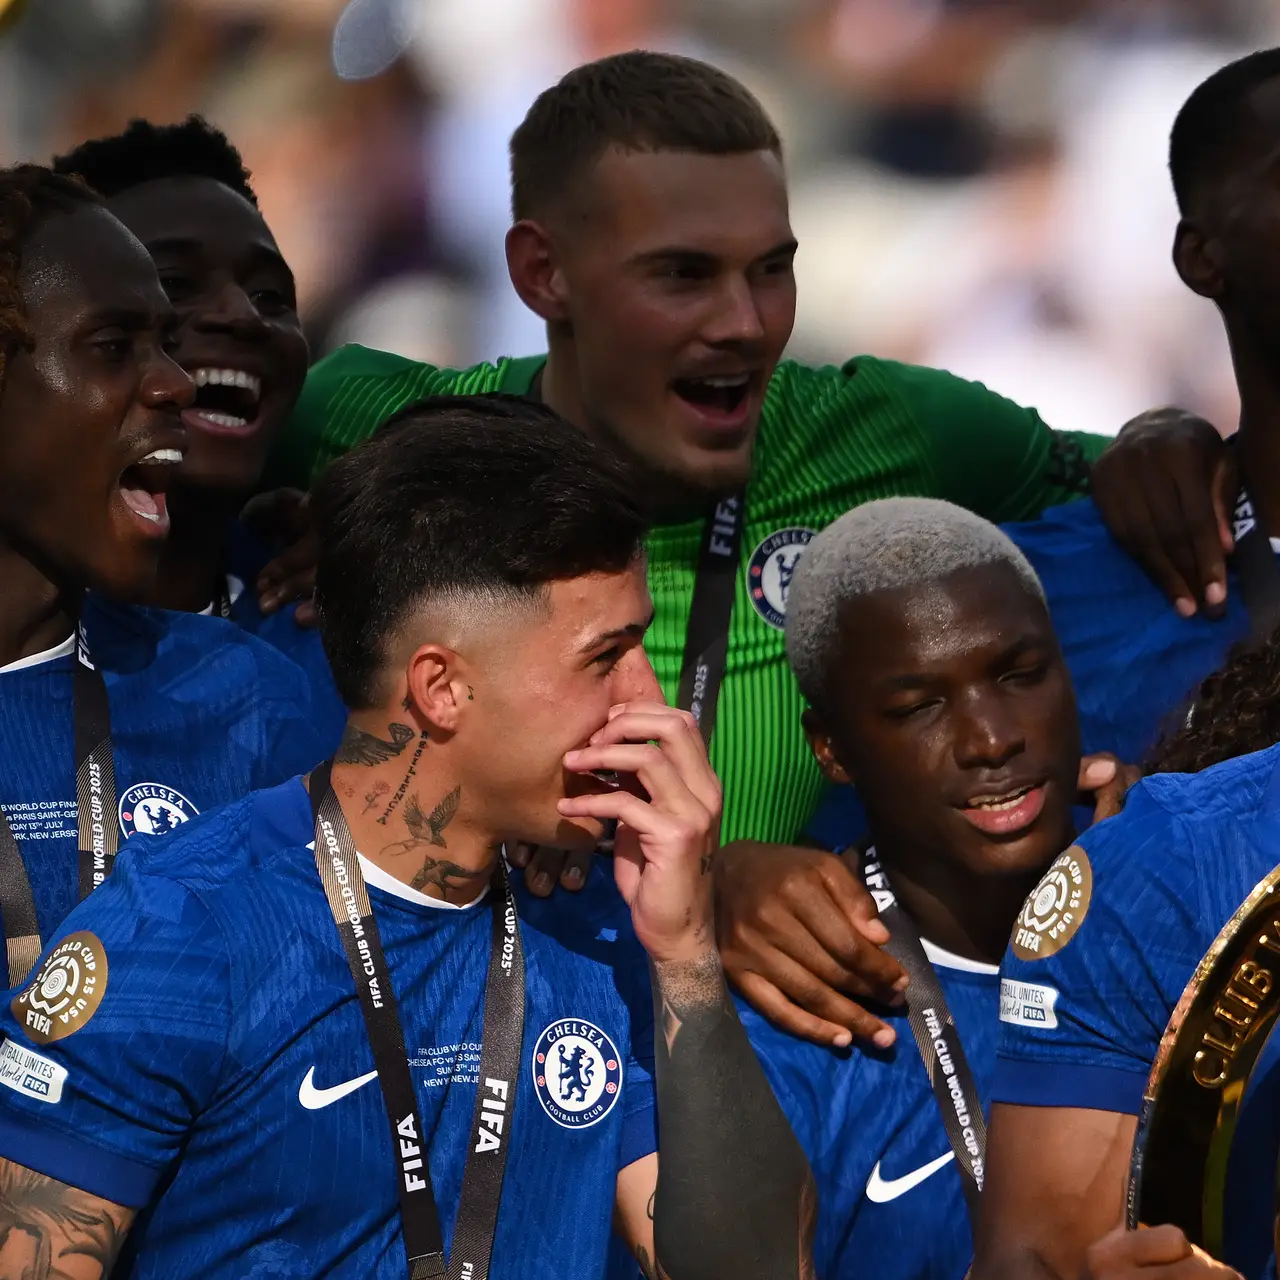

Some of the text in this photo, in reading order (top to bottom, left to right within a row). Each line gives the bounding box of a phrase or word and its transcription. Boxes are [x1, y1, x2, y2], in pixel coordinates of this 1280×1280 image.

[78, 619, 95, 671] FIF
[7, 803, 39, 811] WORLD
[40, 801, 58, 810] CUP
[59, 800, 78, 809] FINA
[91, 791, 103, 820] CUP
[127, 787, 185, 809] CHELSEA
[13, 812, 36, 821] PARIS
[37, 810, 78, 820] SAINT-GE
[44, 820, 63, 829] JULY
[30, 829, 78, 840] NEW JERSE
[93, 825, 105, 869] WORLD
[333, 857, 348, 884] CUP
[342, 886, 365, 939] WORLD
[1048, 860, 1083, 940] CUP 25 USA
[504, 907, 517, 934] CUP
[1015, 927, 1042, 953] FIFA
[357, 939, 376, 976] CLUB
[44, 941, 96, 1025] WORLD CUP 25 USA
[368, 977, 384, 1010] FIFA
[1018, 986, 1045, 1004] UNITES
[26, 1009, 52, 1036] FIFA
[1024, 1007, 1045, 1020] FIFA
[1192, 959, 1274, 1089] CLUB
[546, 1024, 605, 1049] CHELSEA
[428, 1045, 449, 1055] CLUB
[433, 1056, 445, 1066] FC
[24, 1055, 56, 1079] UNITES
[24, 1077, 48, 1094] FIFA
[424, 1078, 442, 1088] NEW
[451, 1075, 470, 1083] NEW
[922, 1008, 943, 1039] FIFA
[934, 1039, 955, 1075] CLUB
[946, 1074, 970, 1127] WORLD
[962, 1127, 979, 1156] CUP
[475, 1077, 509, 1154] FIFA
[546, 1099, 604, 1123] FOOTBALL CLUB
[397, 1112, 427, 1193] FIFA
